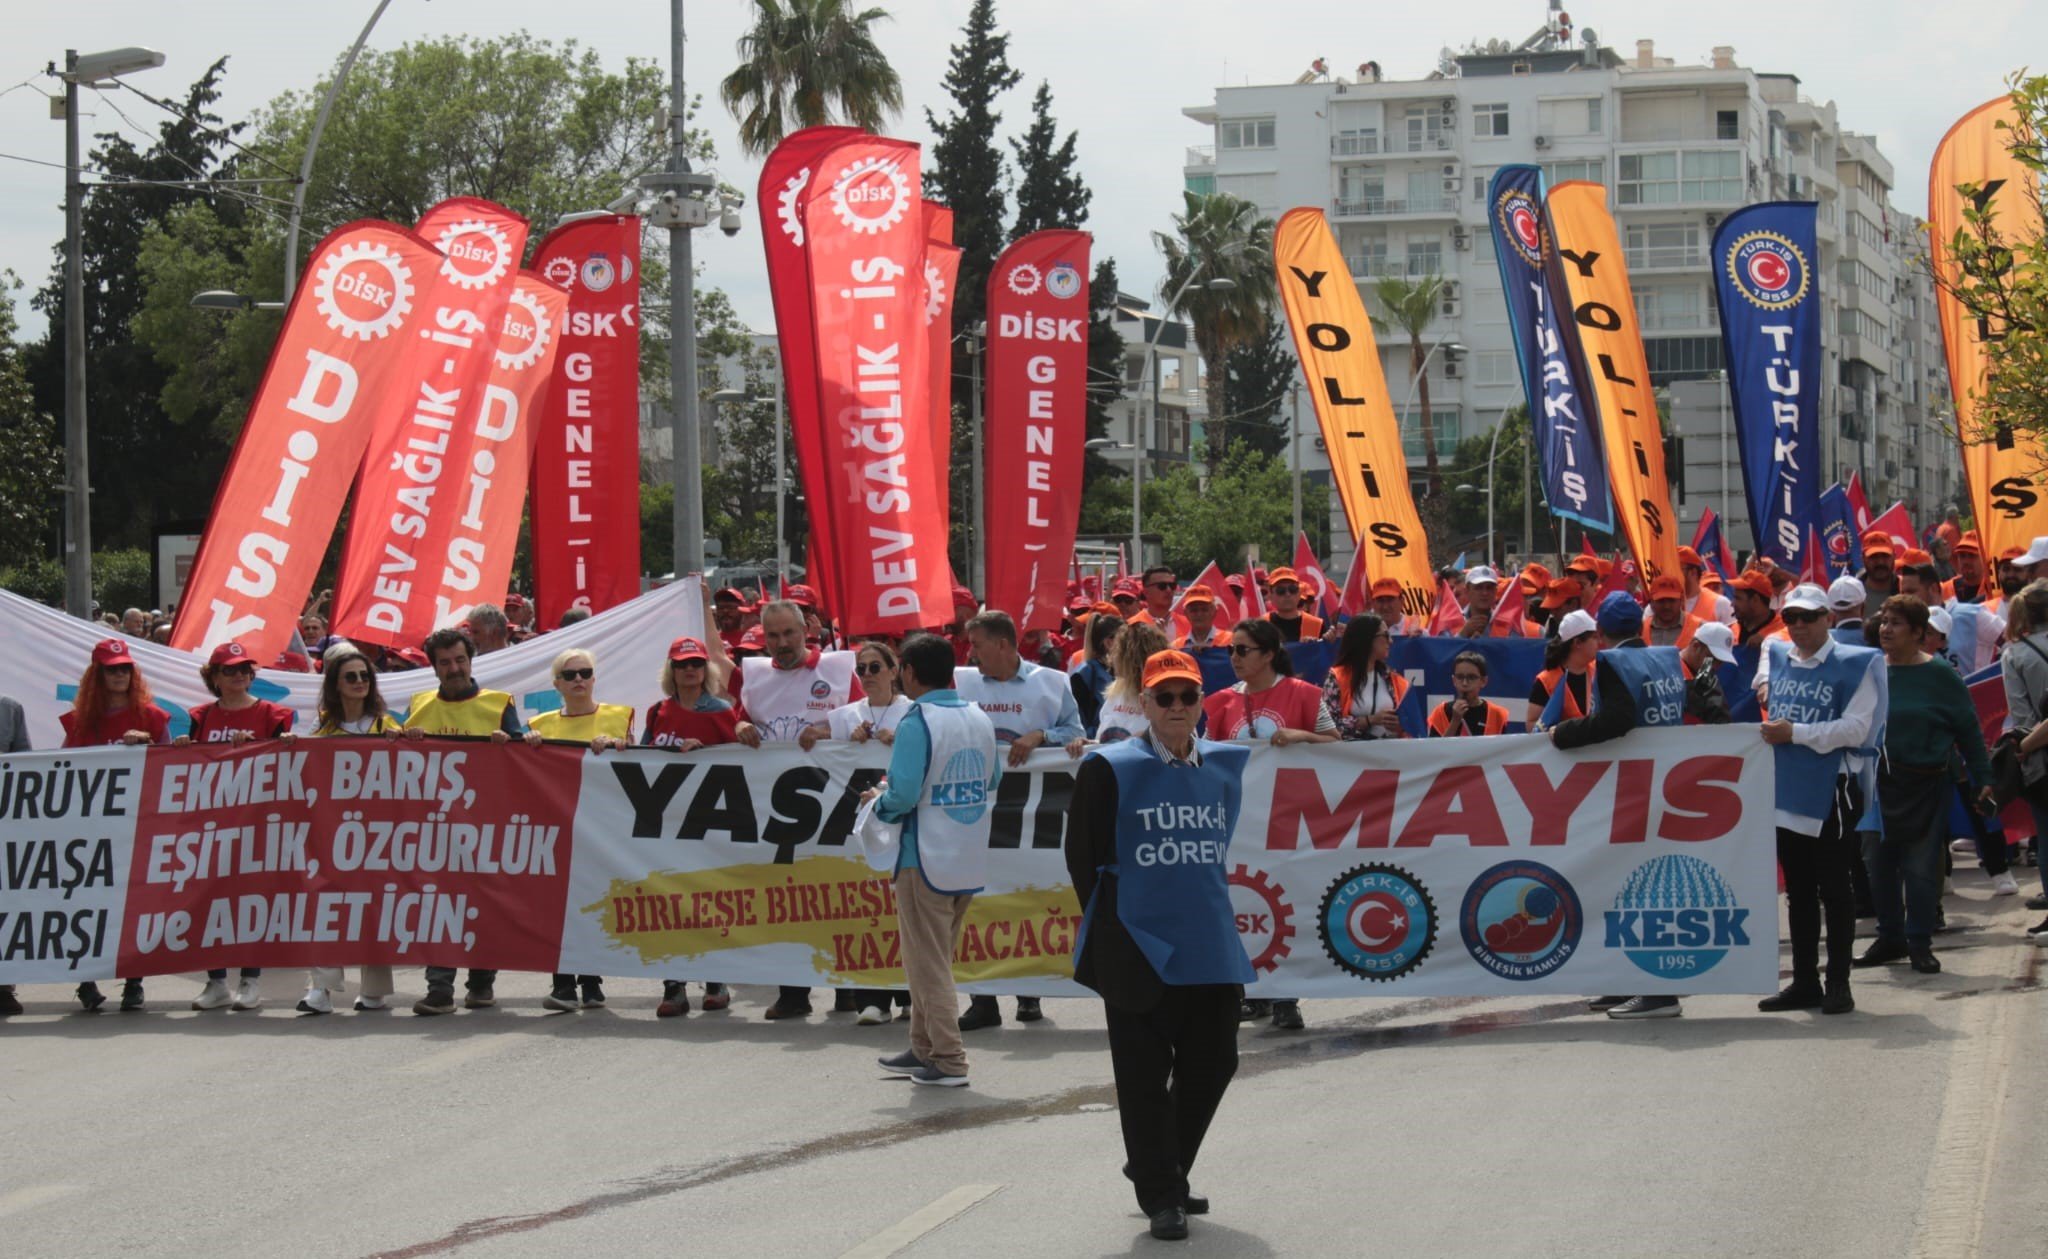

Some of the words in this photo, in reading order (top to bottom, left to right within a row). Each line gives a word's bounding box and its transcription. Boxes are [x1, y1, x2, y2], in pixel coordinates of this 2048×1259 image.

[848, 181, 892, 203] DİSK
[451, 242, 495, 264] DİSK
[337, 271, 394, 310] DİSK
[840, 255, 905, 300] İŞ
[420, 305, 485, 349] İŞ
[502, 312, 535, 342] İSK
[560, 305, 617, 338] İSK
[1000, 310, 1082, 342] DİSK
[849, 342, 912, 515] SAĞLIK
[1289, 265, 1408, 558] YOL-İŞ
[390, 380, 462, 540] SAĞLIK
[1760, 325, 1802, 563] TÜRK-İŞ
[365, 547, 417, 634] DEV
[869, 524, 921, 618] DEV
[157, 751, 318, 813] EKMEK,
[330, 750, 477, 813] BARIŞ,
[930, 778, 988, 806] KES
[1265, 754, 1745, 851] MAYIS
[0, 838, 114, 900] VAŞA
[146, 812, 320, 893] EŞİTLİK,
[332, 810, 561, 877] ÖZGÜRLÜK
[612, 885, 758, 938] BİRLEŞE
[1335, 876, 1419, 908] TÜRK-İŞ
[136, 910, 192, 954] ve
[201, 892, 373, 948] ADALET
[377, 883, 480, 954] İÇİN;
[1235, 913, 1269, 934] SK
[1603, 908, 1750, 948] KESK
[1656, 954, 1697, 970] 1995
